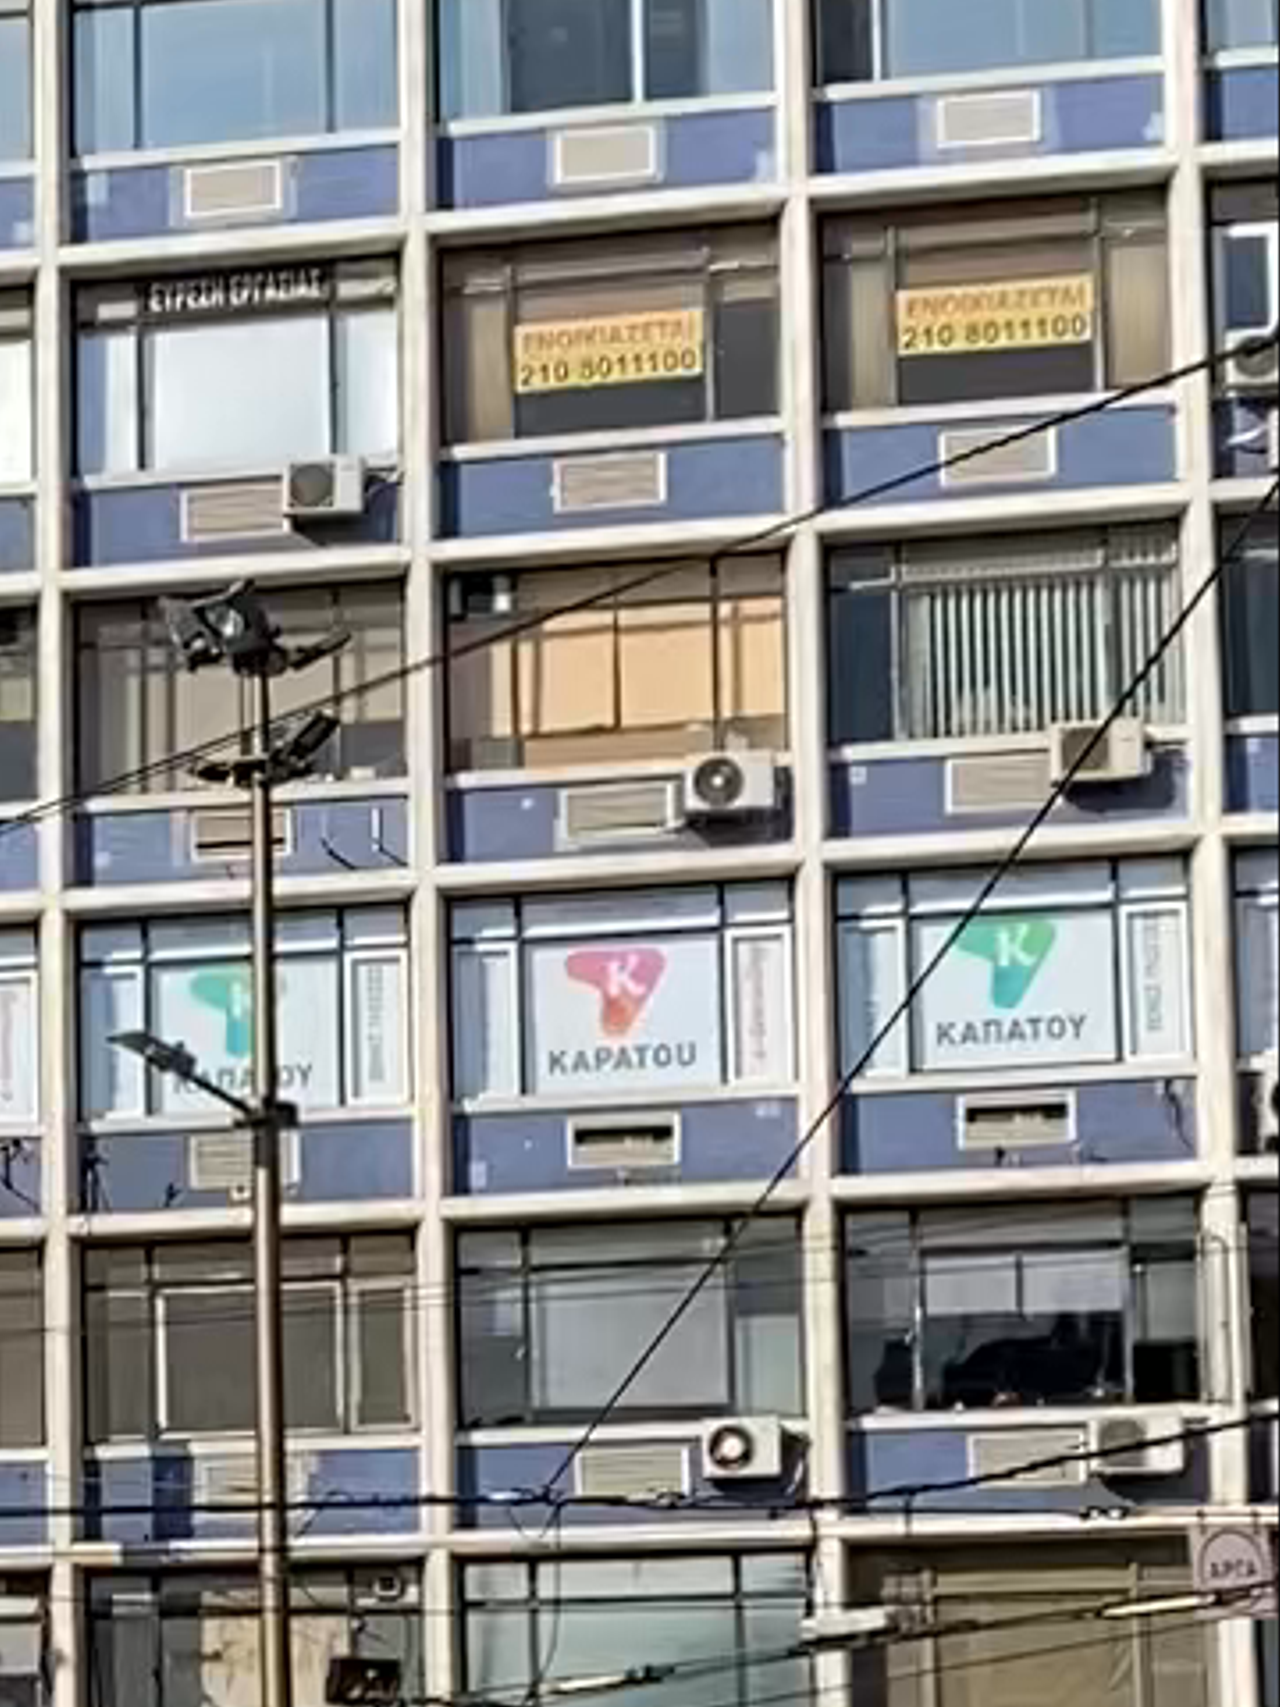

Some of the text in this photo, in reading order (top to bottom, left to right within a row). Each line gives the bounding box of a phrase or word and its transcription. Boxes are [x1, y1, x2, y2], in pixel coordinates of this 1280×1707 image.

[903, 314, 1088, 349] 210 8011100
[520, 360, 569, 388] 210
